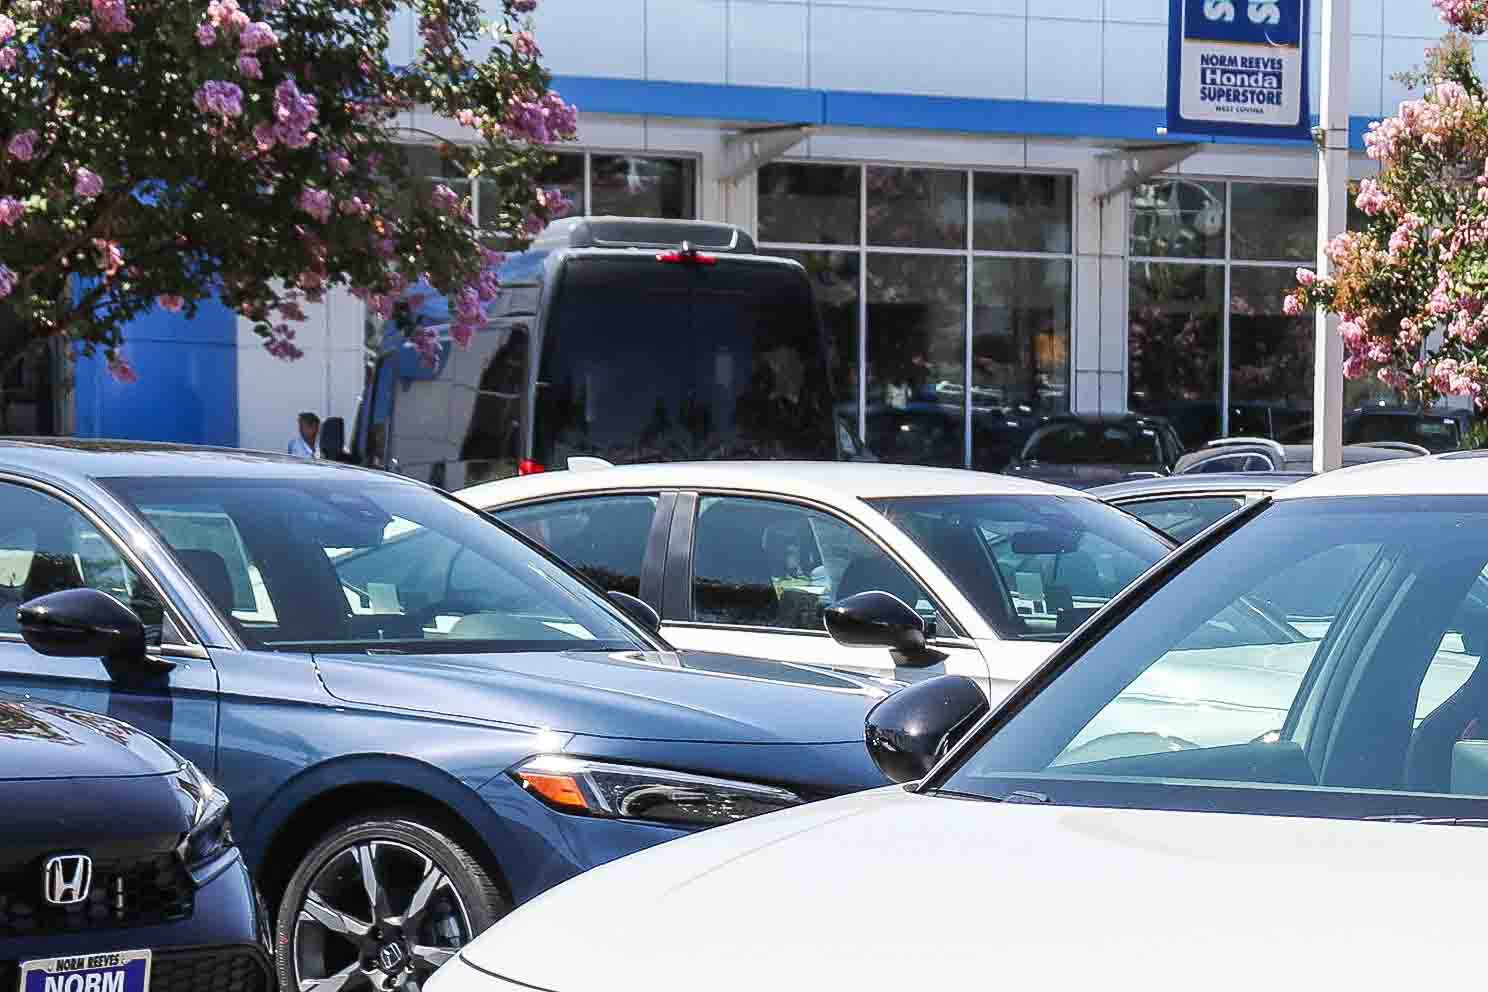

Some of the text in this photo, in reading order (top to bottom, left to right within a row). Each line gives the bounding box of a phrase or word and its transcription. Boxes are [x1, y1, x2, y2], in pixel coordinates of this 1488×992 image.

[1200, 54, 1283, 71] NORM REEVES
[1205, 69, 1278, 88] Honda
[1200, 86, 1282, 106] SUPERSTORE
[56, 953, 120, 972] NORM REEVES
